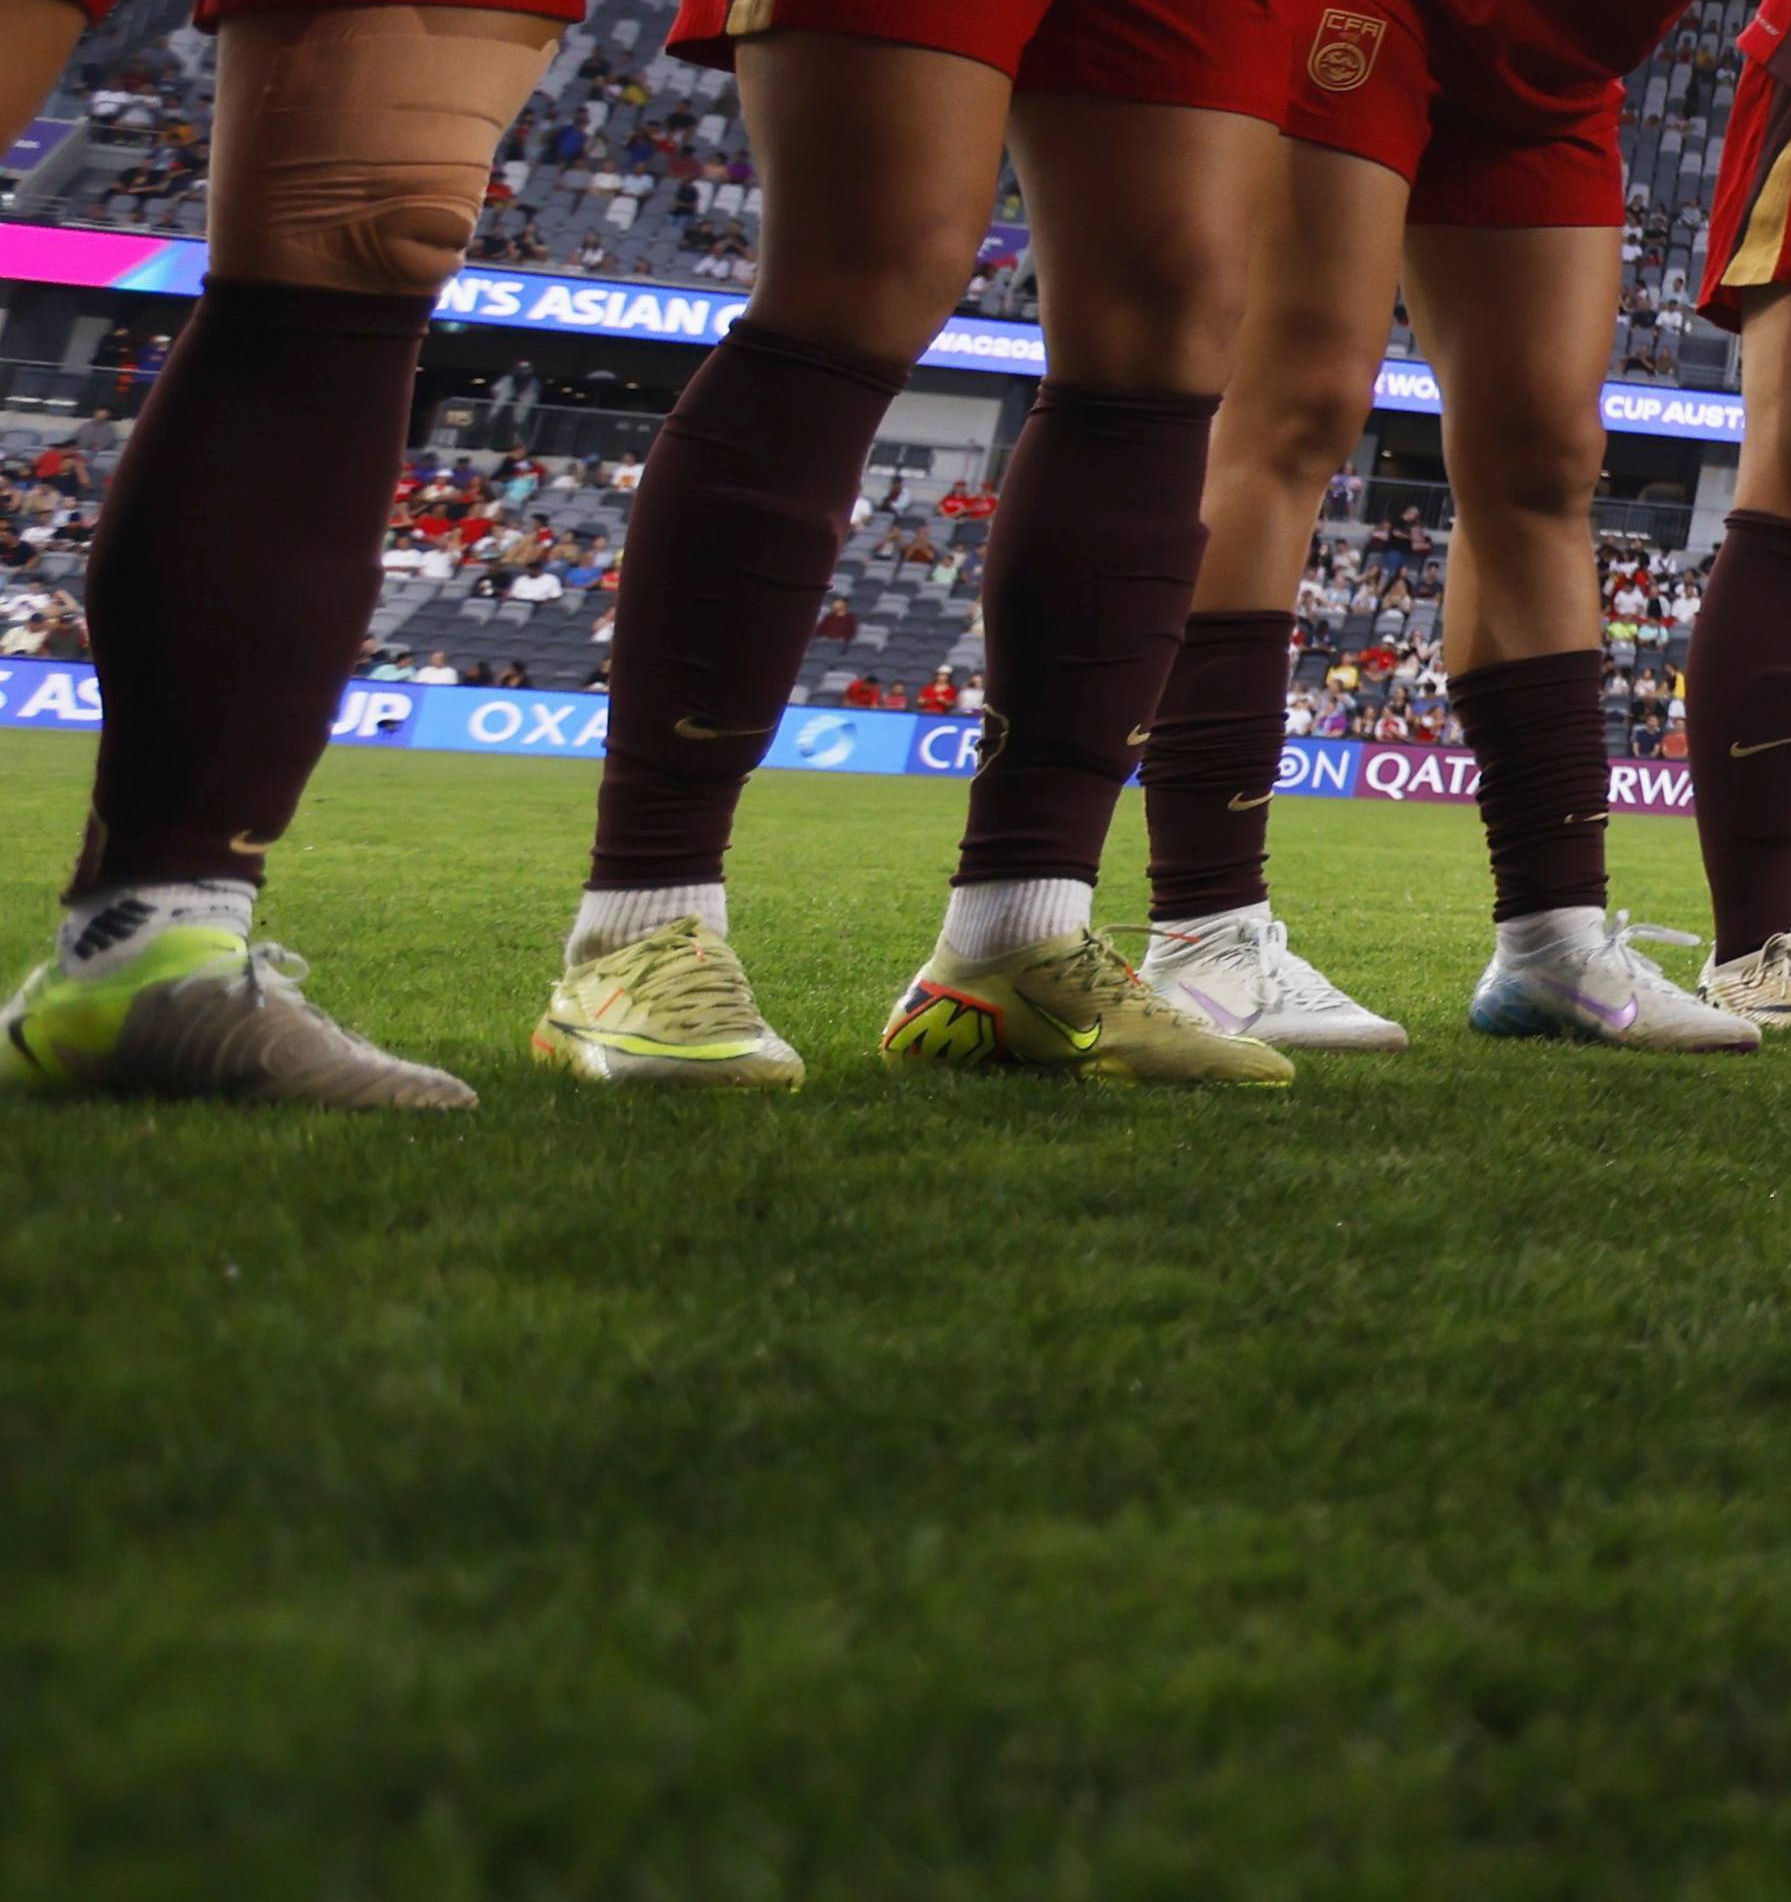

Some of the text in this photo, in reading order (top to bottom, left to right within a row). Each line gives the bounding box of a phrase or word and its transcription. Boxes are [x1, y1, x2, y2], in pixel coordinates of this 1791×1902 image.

[1326, 14, 1381, 37] CFA
[527, 283, 710, 336] ASIAN
[1604, 395, 1663, 424] CUP
